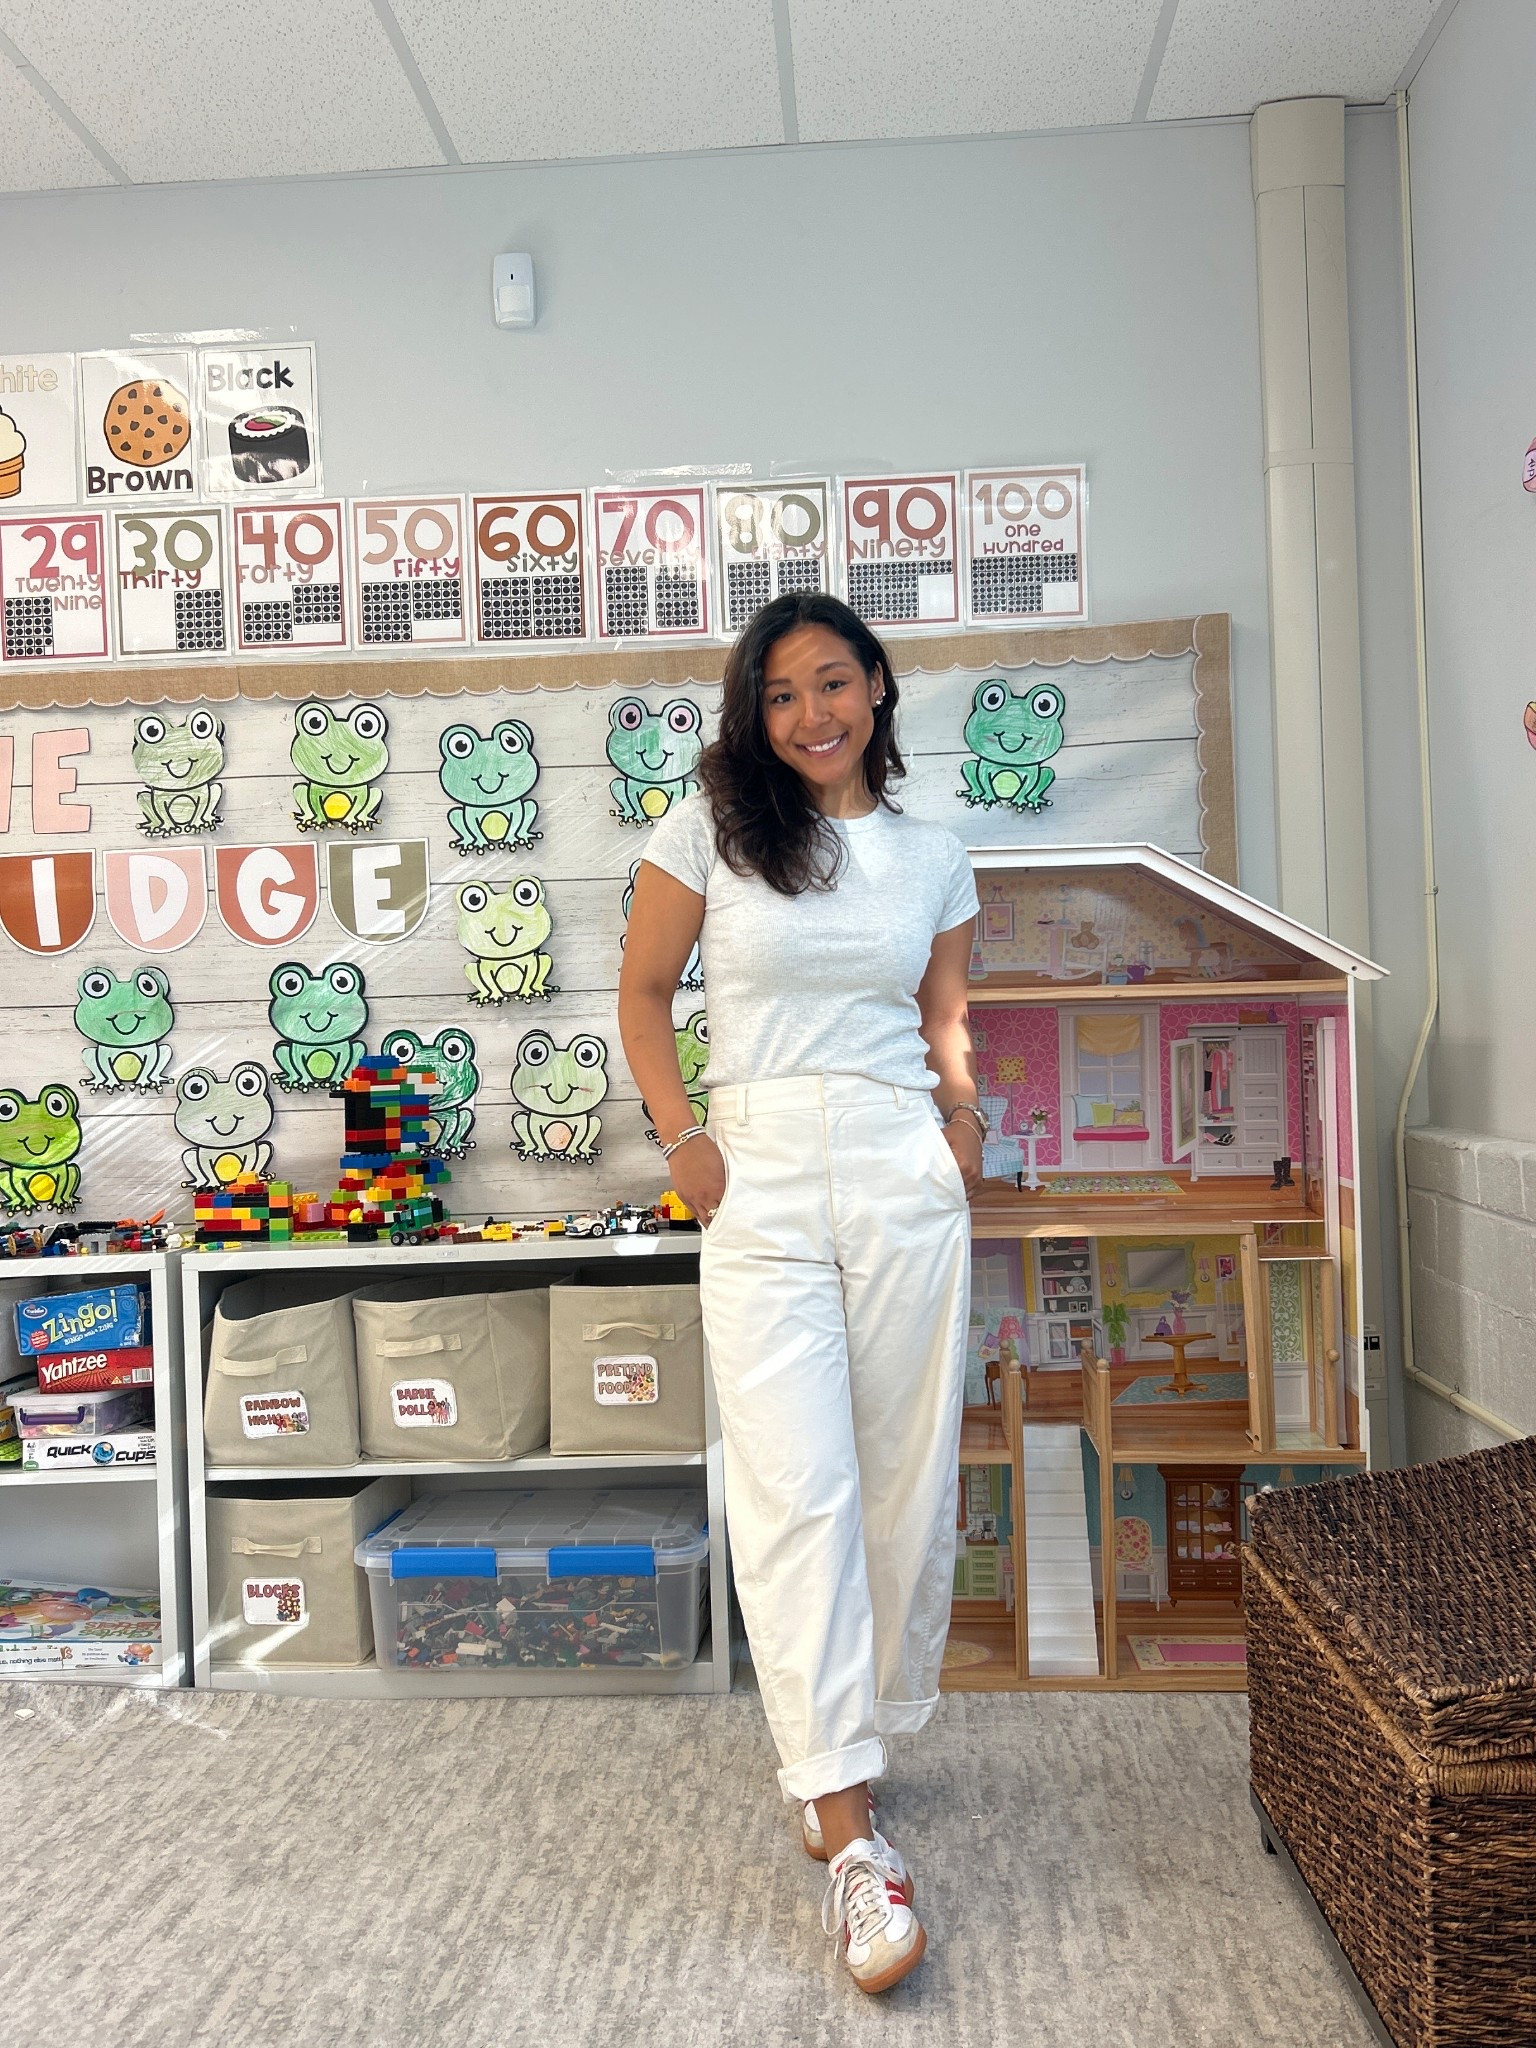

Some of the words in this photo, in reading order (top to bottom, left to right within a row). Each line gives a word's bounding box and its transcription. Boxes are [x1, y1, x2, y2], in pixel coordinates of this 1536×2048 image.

[0, 364, 58, 393] hite
[208, 360, 294, 391] Black
[88, 466, 193, 494] Brown
[852, 486, 947, 541] 90
[975, 480, 1073, 525] 100
[362, 508, 454, 565] 50
[478, 504, 576, 562] 60
[602, 499, 695, 556] 70
[725, 493, 821, 554] 80
[21, 523, 97, 579] 29
[122, 519, 213, 576] 30
[241, 513, 334, 569] 40
[849, 536, 946, 560] Ninety
[983, 538, 1064, 555] Hundred
[119, 568, 202, 590] Thirty
[238, 563, 314, 584] Forty
[394, 556, 461, 578] Fifty
[15, 572, 102, 593] Twenty
[54, 594, 102, 611] Nine
[0, 728, 91, 834] E
[42, 1289, 118, 1344] Zingo!
[40, 1353, 108, 1384] Yahtzee
[597, 1363, 653, 1377] PRETEND
[397, 1388, 436, 1400] BARBIE
[598, 1381, 632, 1395] FOOD
[245, 1397, 301, 1411] RAINBOW
[247, 1584, 300, 1598] BLOCKS
